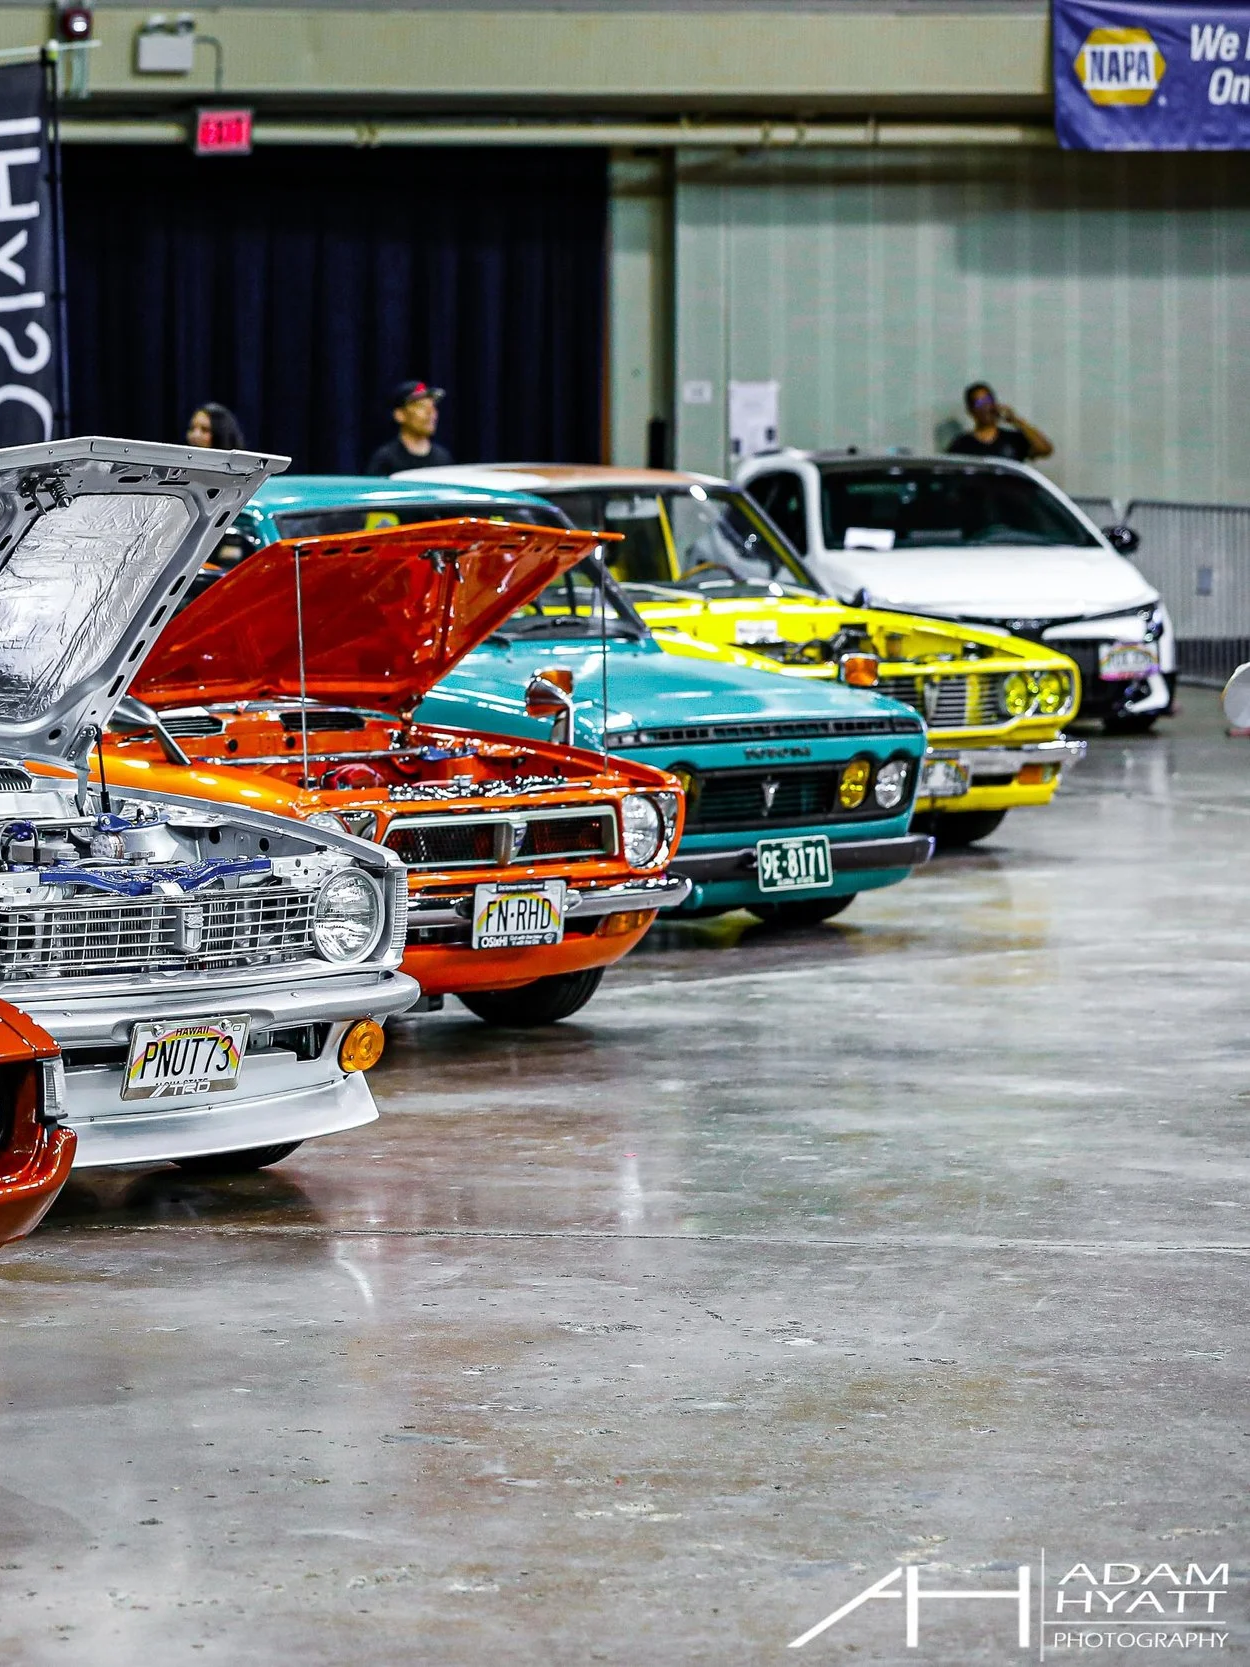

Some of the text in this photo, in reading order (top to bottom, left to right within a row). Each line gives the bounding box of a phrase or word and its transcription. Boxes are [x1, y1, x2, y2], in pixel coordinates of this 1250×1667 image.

[1190, 23, 1241, 62] We
[1090, 50, 1151, 84] NAPA
[176, 1026, 209, 1037] HAWAII
[139, 1035, 234, 1080] PNUT73
